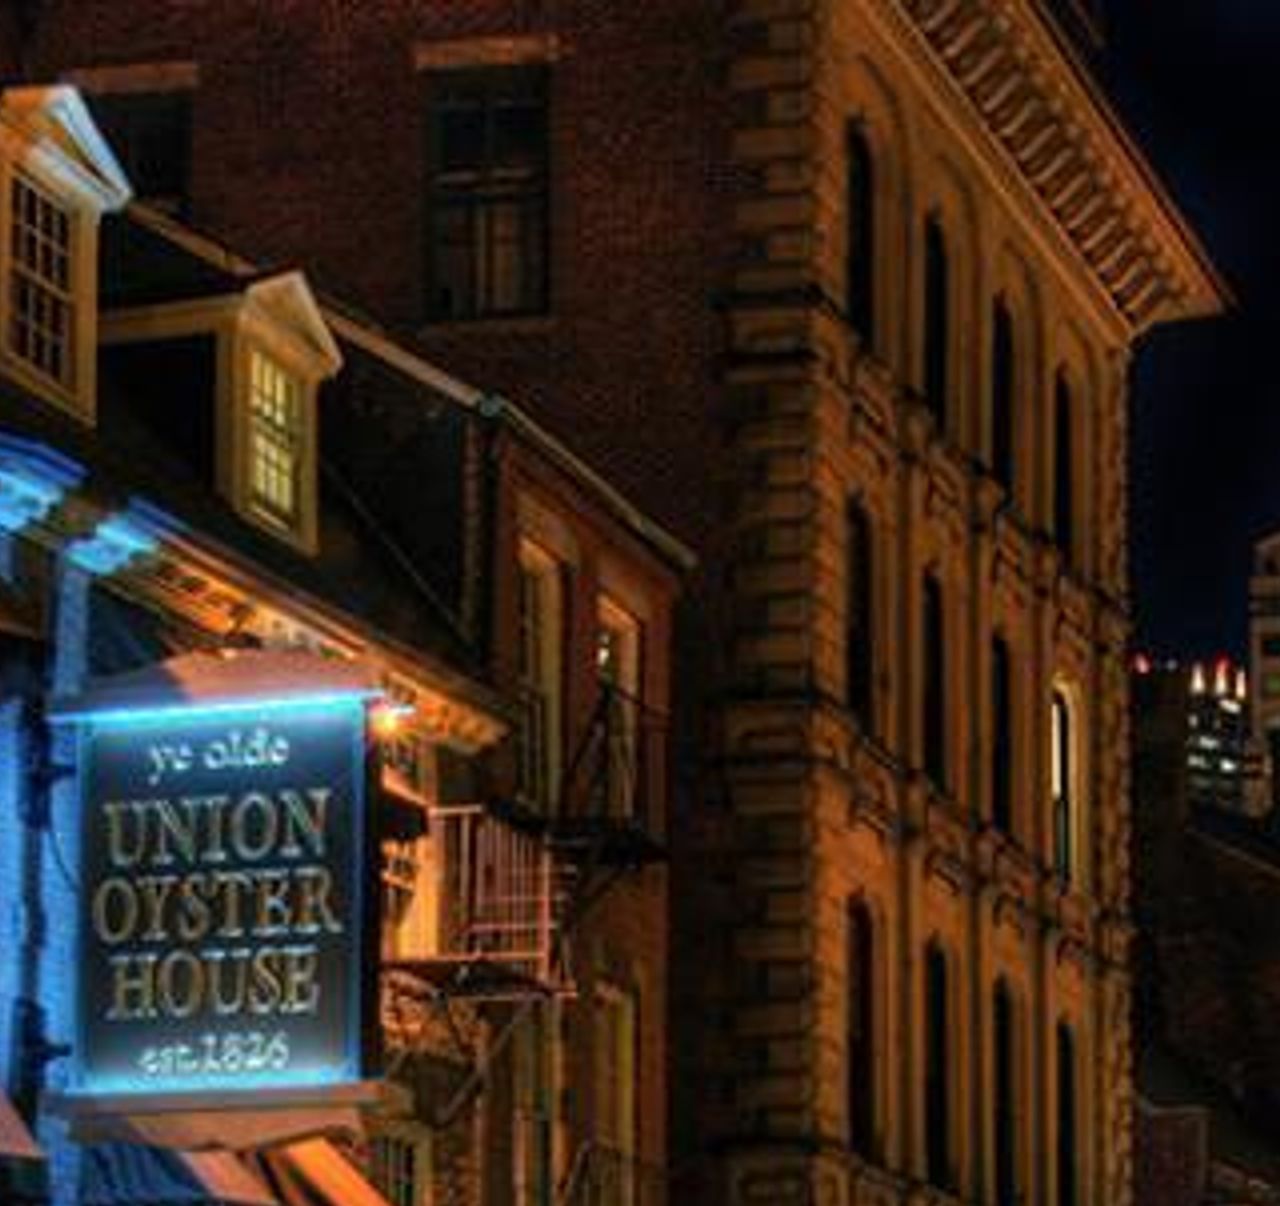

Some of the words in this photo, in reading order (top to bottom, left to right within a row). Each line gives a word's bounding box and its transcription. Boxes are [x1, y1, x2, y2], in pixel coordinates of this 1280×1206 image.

[148, 743, 192, 784] ye
[204, 727, 290, 768] olde
[104, 788, 333, 867] UNION
[92, 866, 343, 944] OYSTER
[106, 945, 320, 1021] HOUSE
